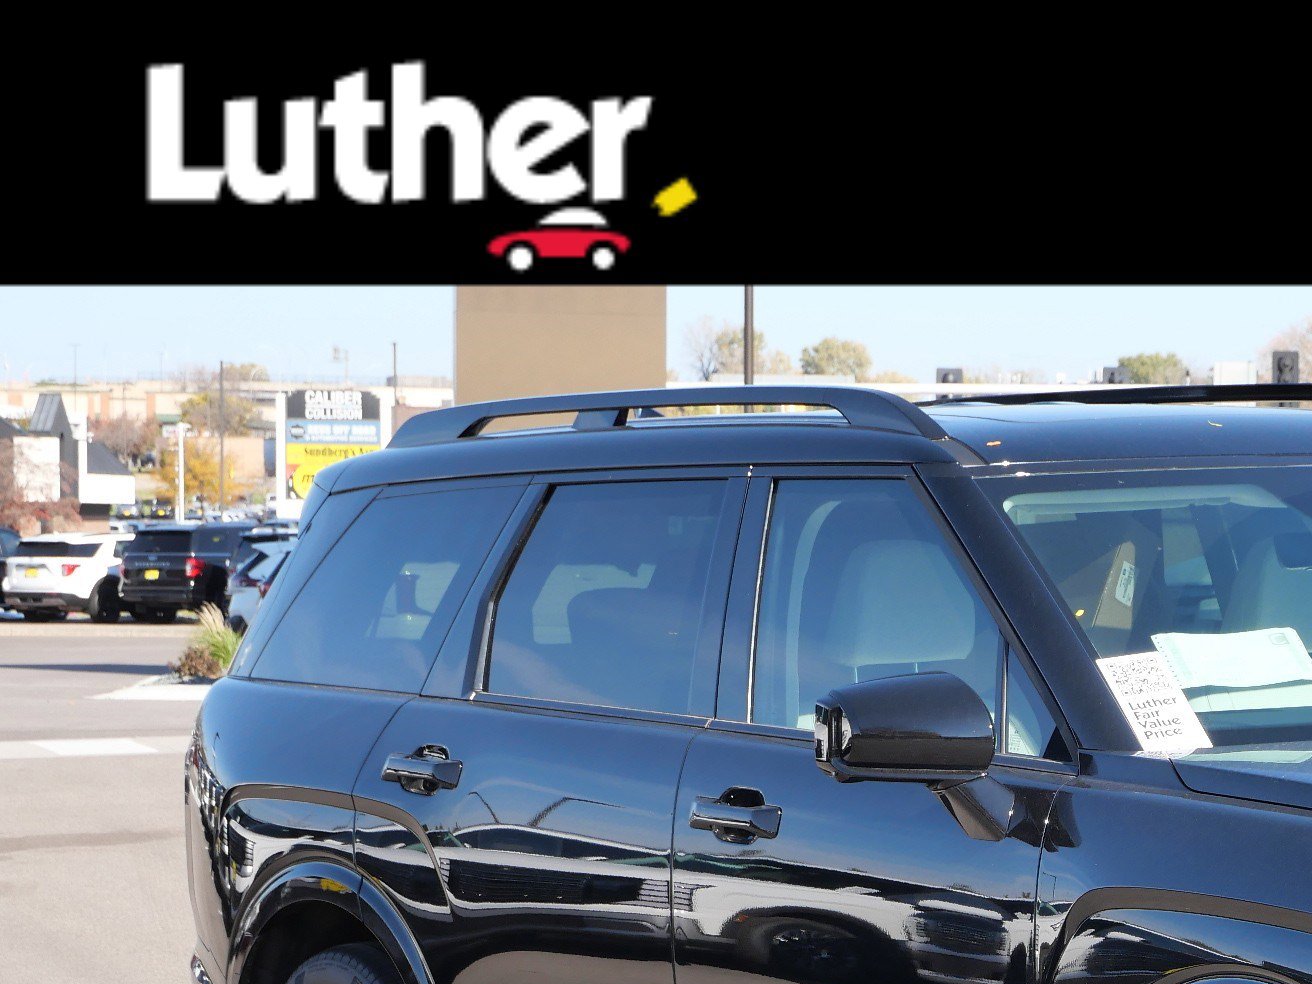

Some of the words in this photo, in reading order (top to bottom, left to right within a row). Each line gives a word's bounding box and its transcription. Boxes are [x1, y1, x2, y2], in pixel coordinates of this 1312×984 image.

[305, 390, 362, 406] CALIBER
[305, 407, 363, 420] COLLISION
[1128, 697, 1177, 711] Luther
[1134, 710, 1160, 720] Fair
[1138, 717, 1182, 729] Value
[1144, 728, 1183, 740] Price
